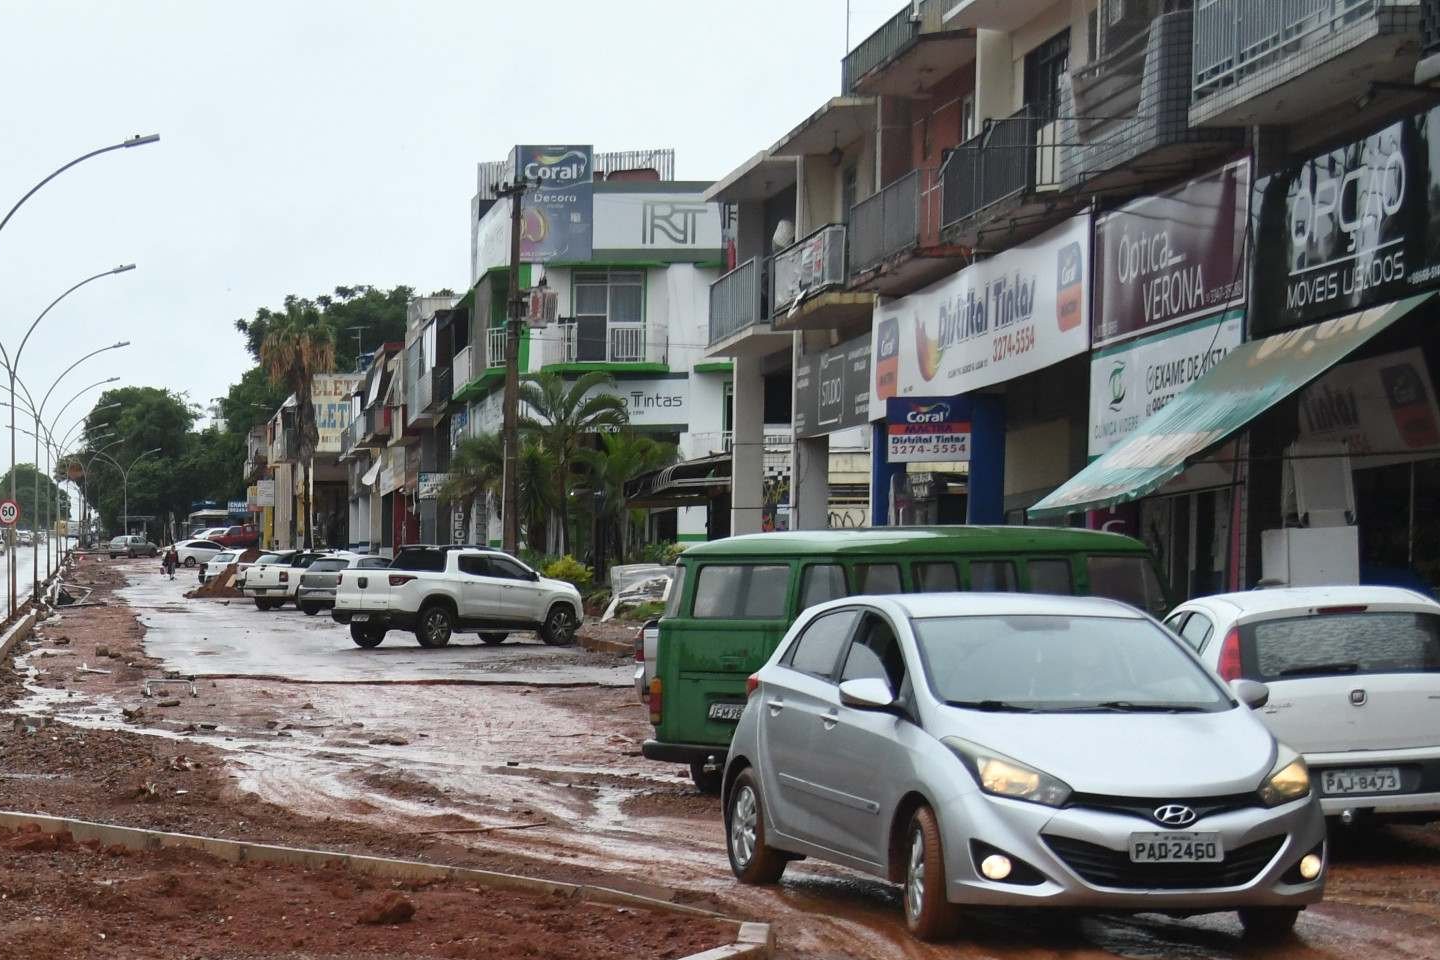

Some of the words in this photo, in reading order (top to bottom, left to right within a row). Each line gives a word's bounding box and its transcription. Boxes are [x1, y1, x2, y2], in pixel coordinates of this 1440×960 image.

[525, 163, 577, 179] Coral
[534, 193, 577, 202] Decora
[1342, 251, 1404, 295] USADOS
[1143, 264, 1204, 322] VERONA
[938, 285, 990, 349] Distrital
[992, 272, 1036, 330] Tintas
[993, 326, 1036, 361] 3274-5554
[1154, 359, 1185, 390] EXAME
[1187, 352, 1199, 381] DE
[630, 391, 682, 407] Tintas
[907, 411, 944, 422] Coral
[892, 436, 933, 444] Distrital
[936, 435, 966, 443] Tintas
[892, 444, 966, 454] 3274-5554
[2, 505, 15, 516] 60
